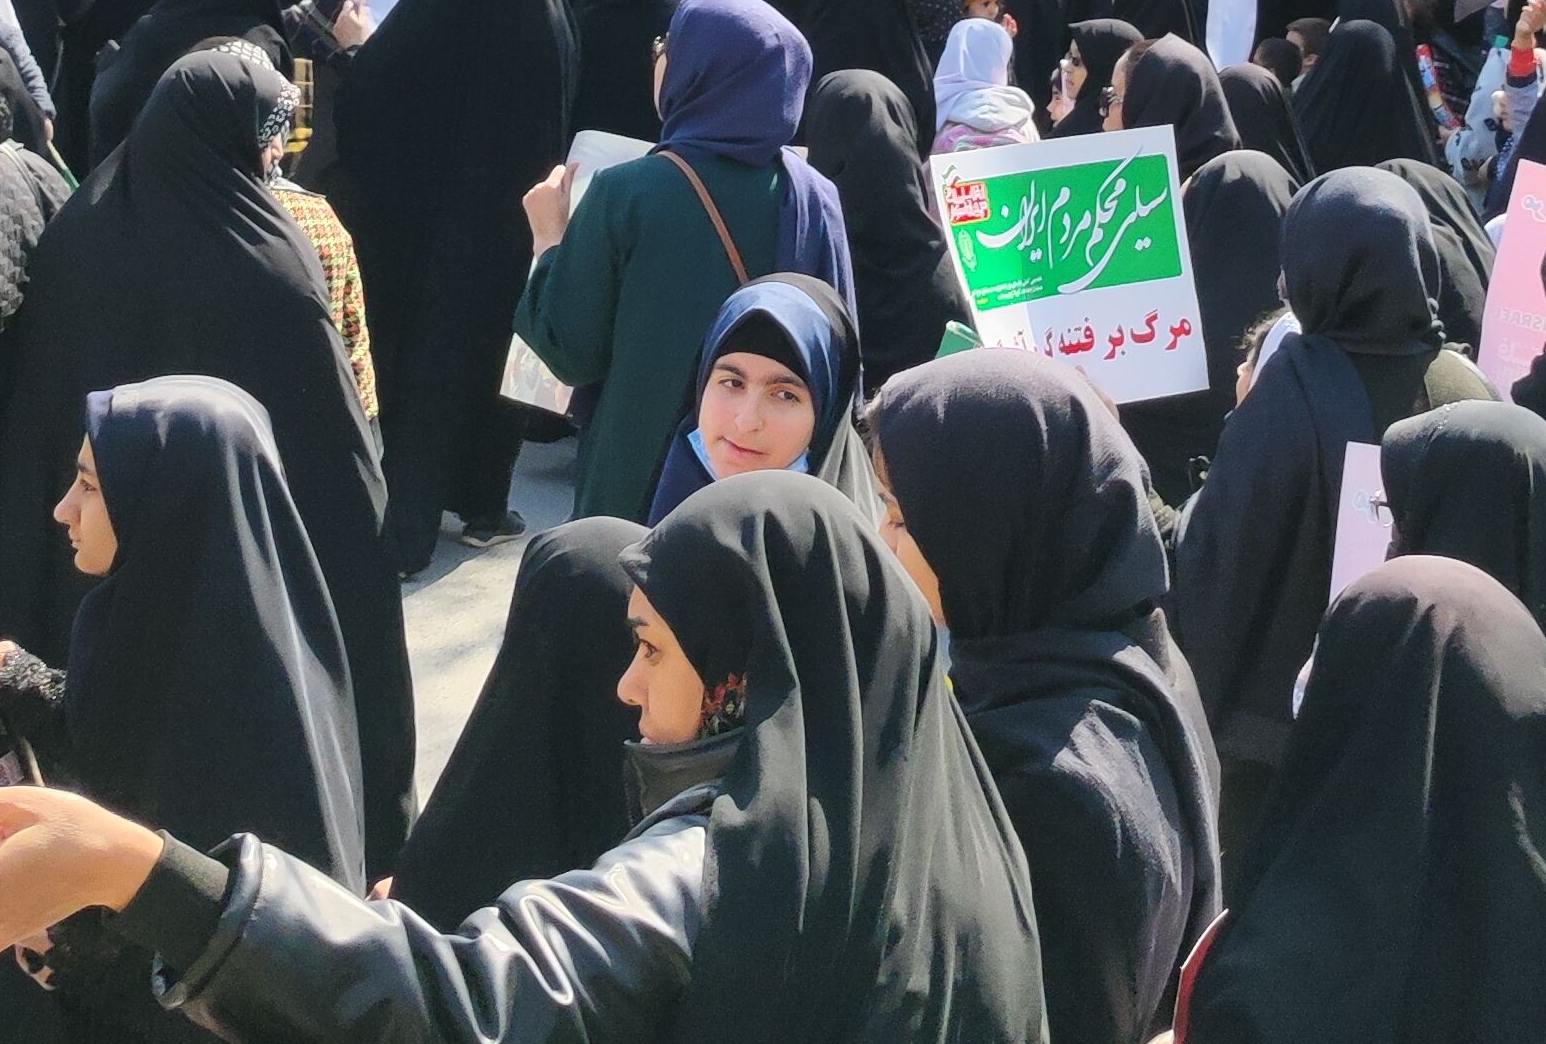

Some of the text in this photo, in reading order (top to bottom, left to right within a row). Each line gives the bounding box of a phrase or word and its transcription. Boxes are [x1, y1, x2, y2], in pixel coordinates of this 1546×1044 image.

[975, 178, 1047, 264] ایران
[1047, 185, 1093, 270] مردم
[1057, 184, 1169, 295] سیلی
[1084, 145, 1144, 268] محکم
[1057, 315, 1097, 356] فتنه
[1102, 323, 1126, 362] بر
[1130, 308, 1193, 352] مرگ
